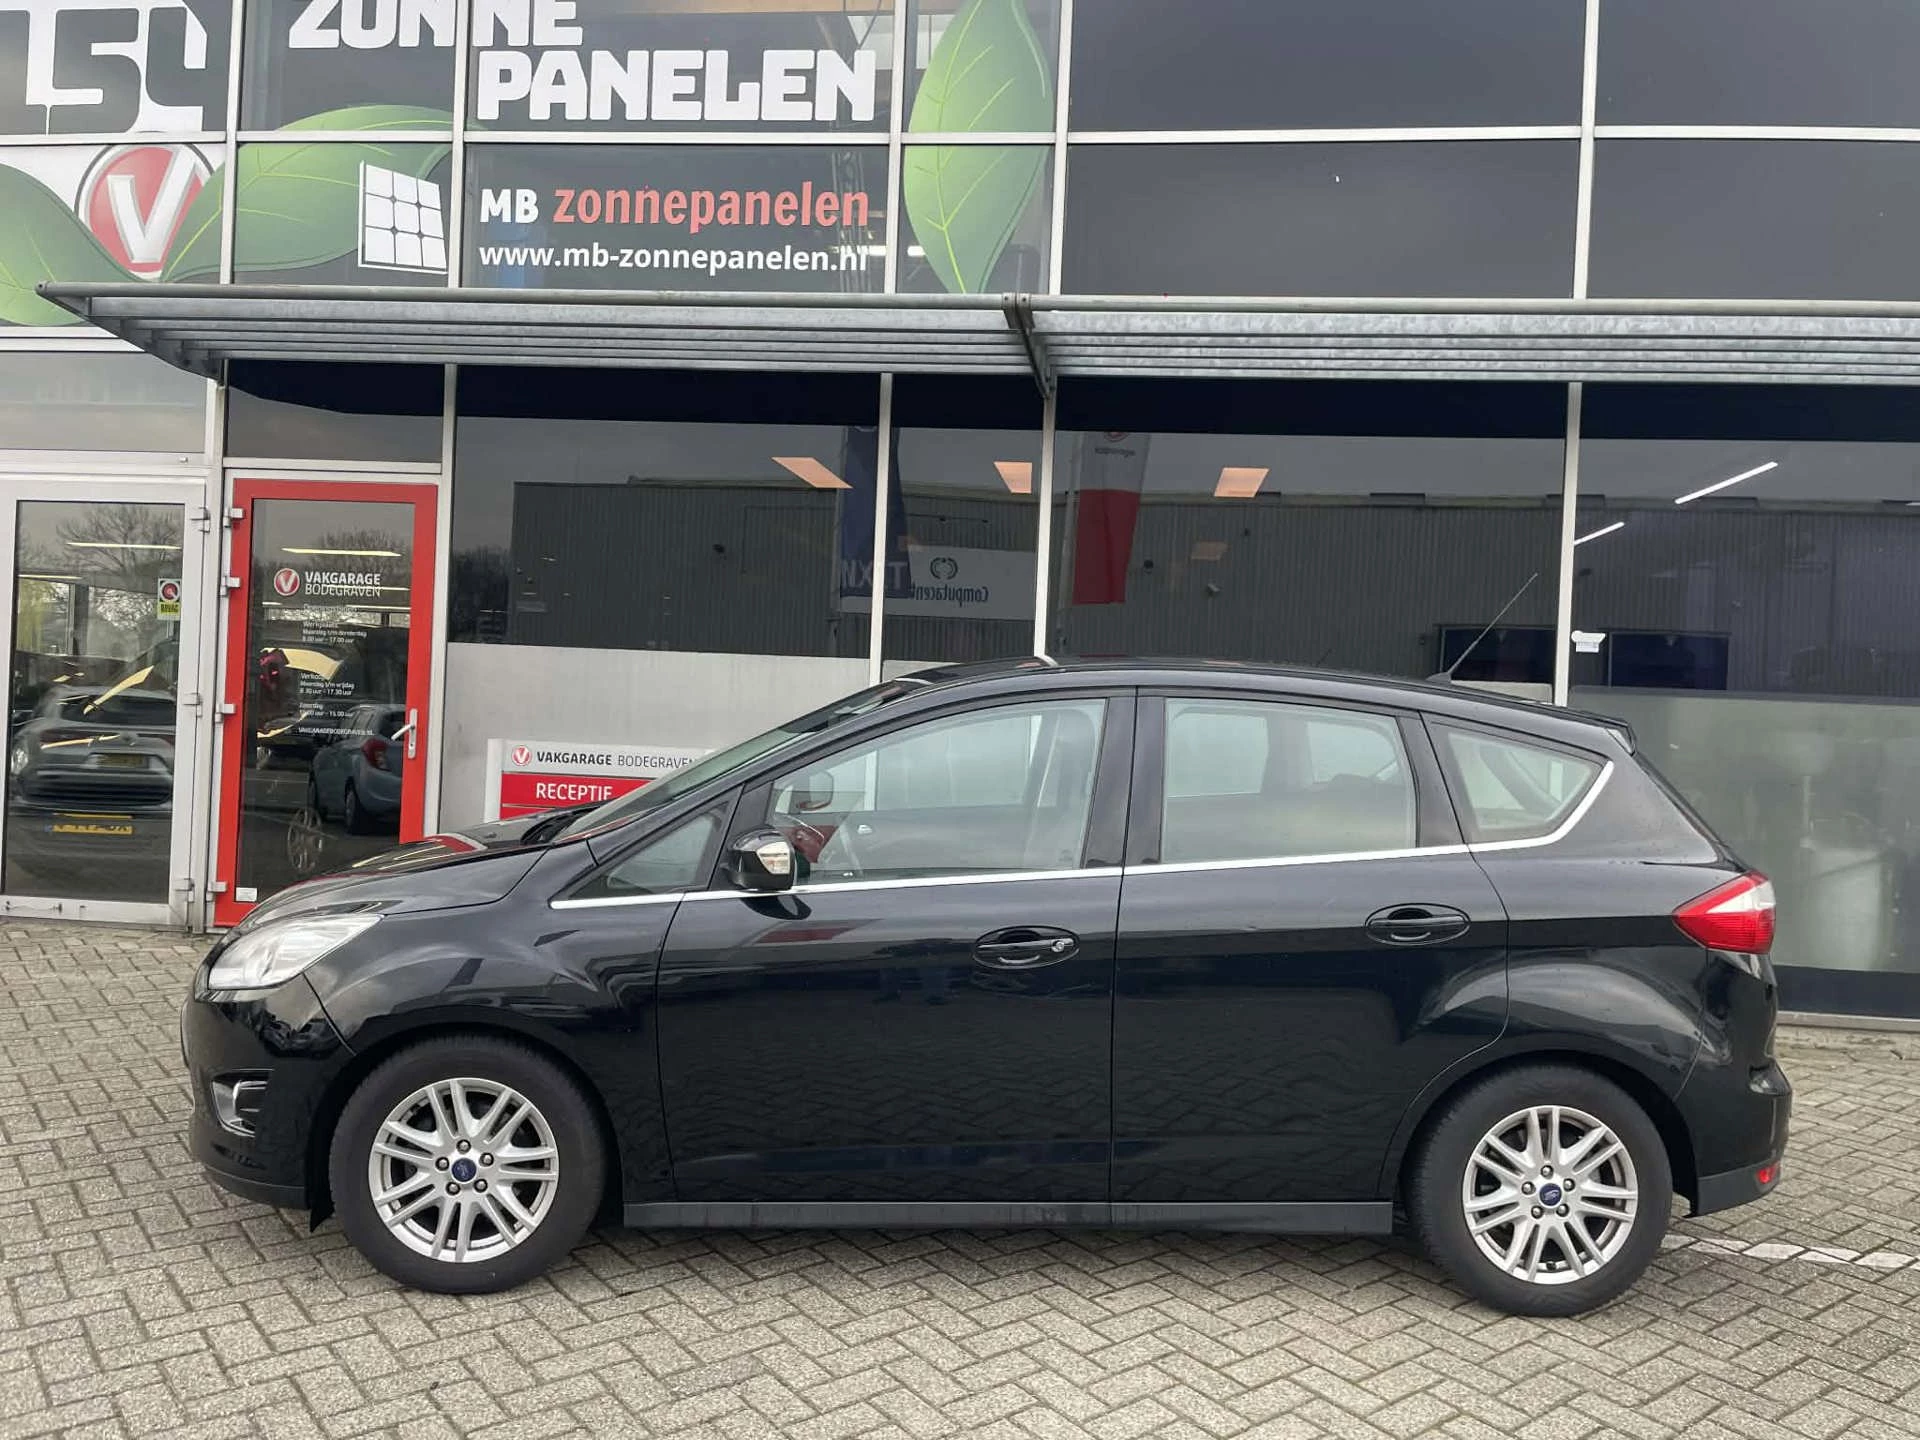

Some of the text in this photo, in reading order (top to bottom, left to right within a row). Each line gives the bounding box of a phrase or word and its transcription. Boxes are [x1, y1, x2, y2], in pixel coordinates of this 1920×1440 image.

[289, 0, 584, 49] ZONNE
[477, 50, 876, 122] PANELEN
[479, 181, 869, 234] MB zonnepanelen
[479, 242, 868, 276] www.mb-zonnepanelen.nl
[304, 571, 381, 586] VAKGARAGE
[304, 583, 381, 597] BODEGRAVEN
[537, 751, 692, 769] VAKGARAGE BODEGRAVE
[536, 782, 613, 801] RECEPTIE
